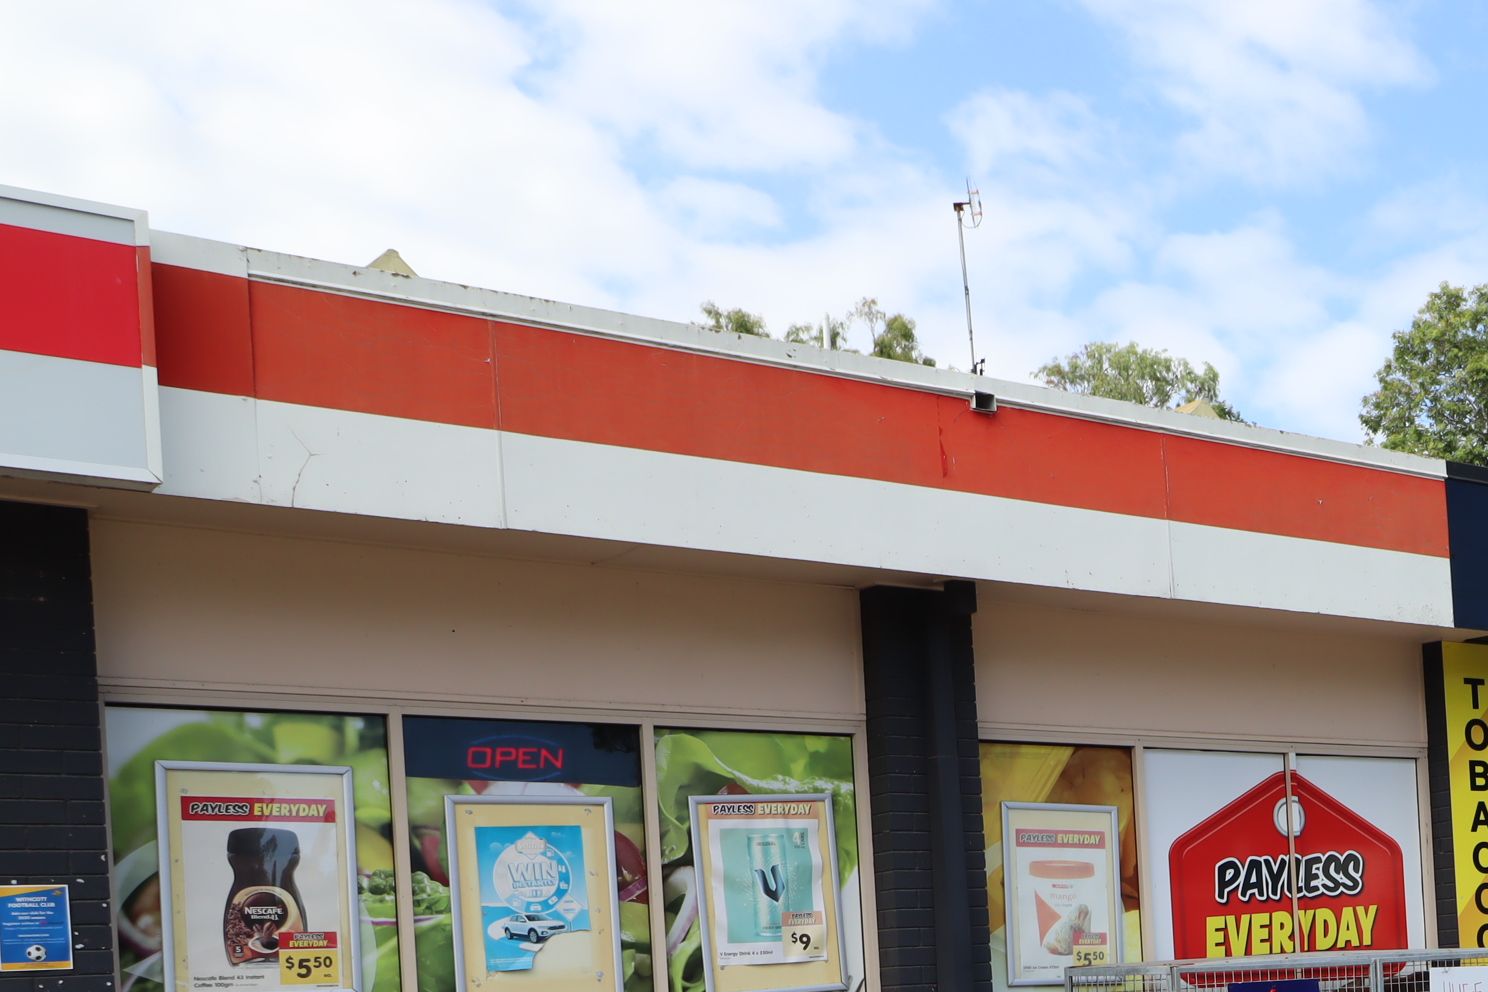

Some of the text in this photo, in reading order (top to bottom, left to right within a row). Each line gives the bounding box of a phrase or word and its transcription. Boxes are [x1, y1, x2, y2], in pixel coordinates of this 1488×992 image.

[467, 747, 564, 769] OPEN
[189, 802, 327, 817] PAYLESS EVERYDAY
[713, 803, 812, 816] PAYLESS EVERYDAY
[1019, 832, 1101, 845] PAYLESS EVERYDAY
[508, 861, 558, 882] WIN
[1214, 850, 1363, 904] PAYLESS
[1206, 905, 1379, 958] EVERYDAY
[289, 940, 328, 948] EVERYDAY
